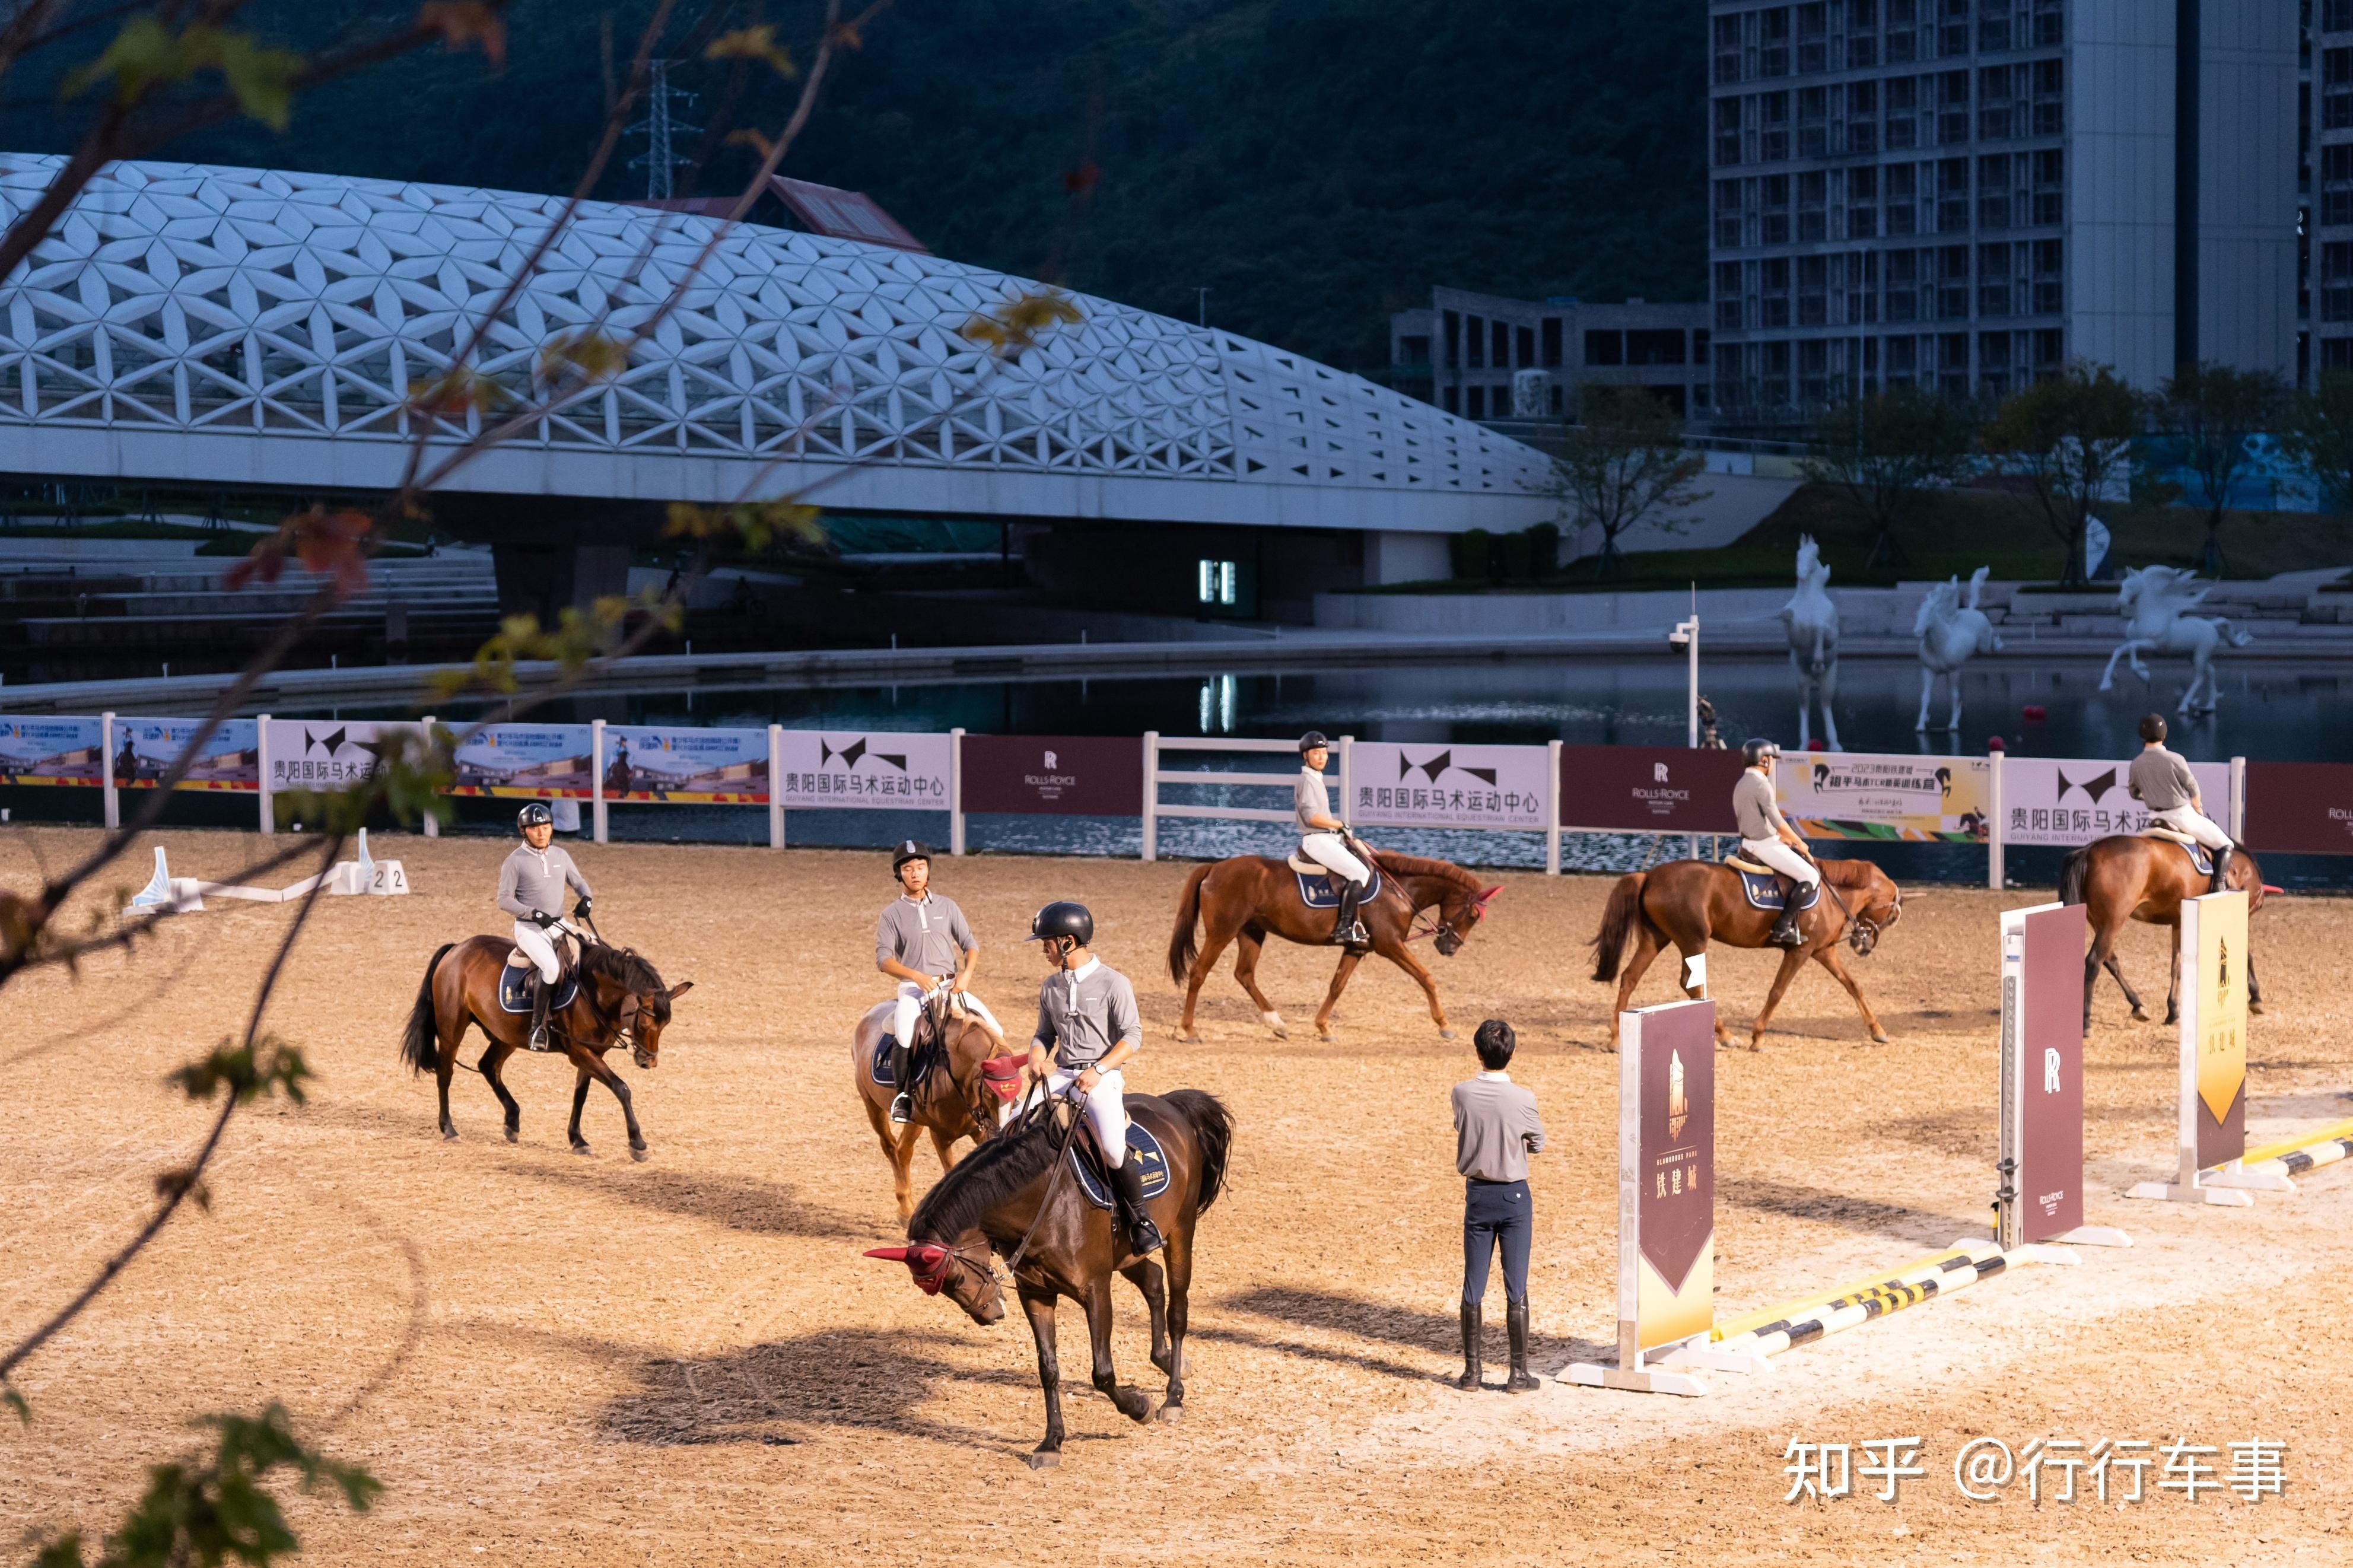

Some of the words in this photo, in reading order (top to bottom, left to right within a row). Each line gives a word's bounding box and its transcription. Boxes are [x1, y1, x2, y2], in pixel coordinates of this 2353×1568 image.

[274, 760, 387, 780] 贵阳国际马术运
[786, 772, 945, 796] 贵阳国际马术运动中心
[1632, 787, 1690, 800] ROLLS-ROYCE
[1359, 787, 1539, 813] 贵阳国际马术运动中心
[1395, 811, 1453, 819] INTERNATIONAL
[1457, 813, 1505, 822] EQUESTRIAN
[374, 870, 384, 888] 2
[394, 870, 402, 887] 2
[1656, 1164, 1697, 1200] 铁建城
